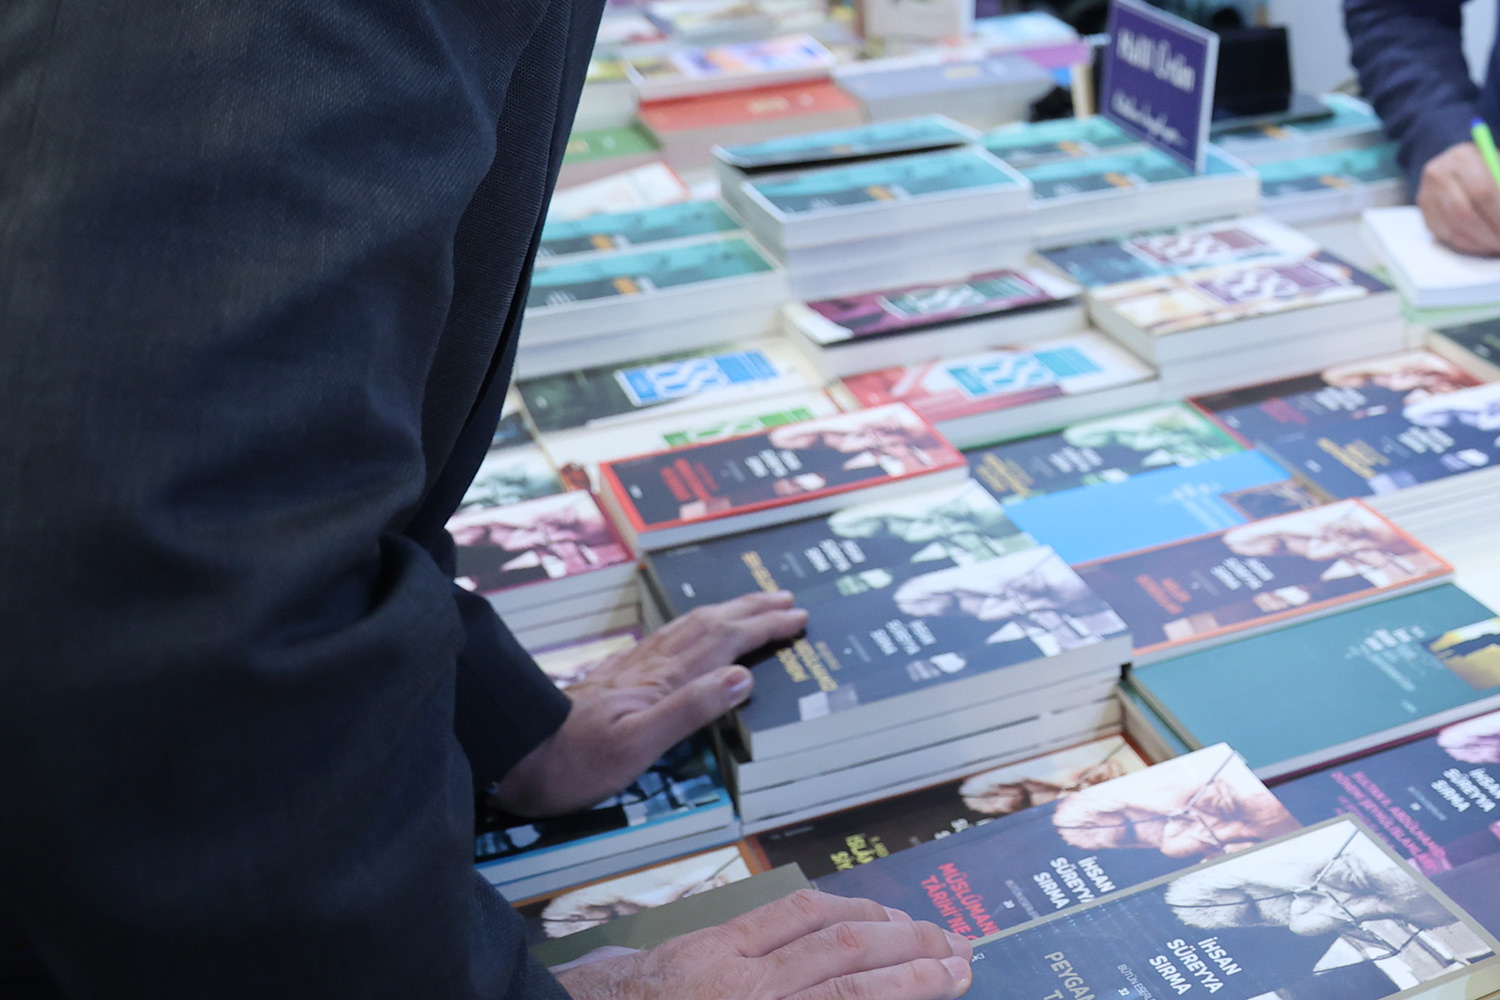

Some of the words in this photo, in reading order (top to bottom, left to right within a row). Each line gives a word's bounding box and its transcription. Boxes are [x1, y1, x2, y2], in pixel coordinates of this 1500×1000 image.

[1033, 871, 1070, 909] SIRMA
[1077, 855, 1116, 893] İHSAN
[1117, 963, 1137, 985] BÜTÜN
[1149, 954, 1193, 995] SIRMA
[1166, 938, 1224, 994] SÜREYYA
[1197, 936, 1243, 976] İHSAN
